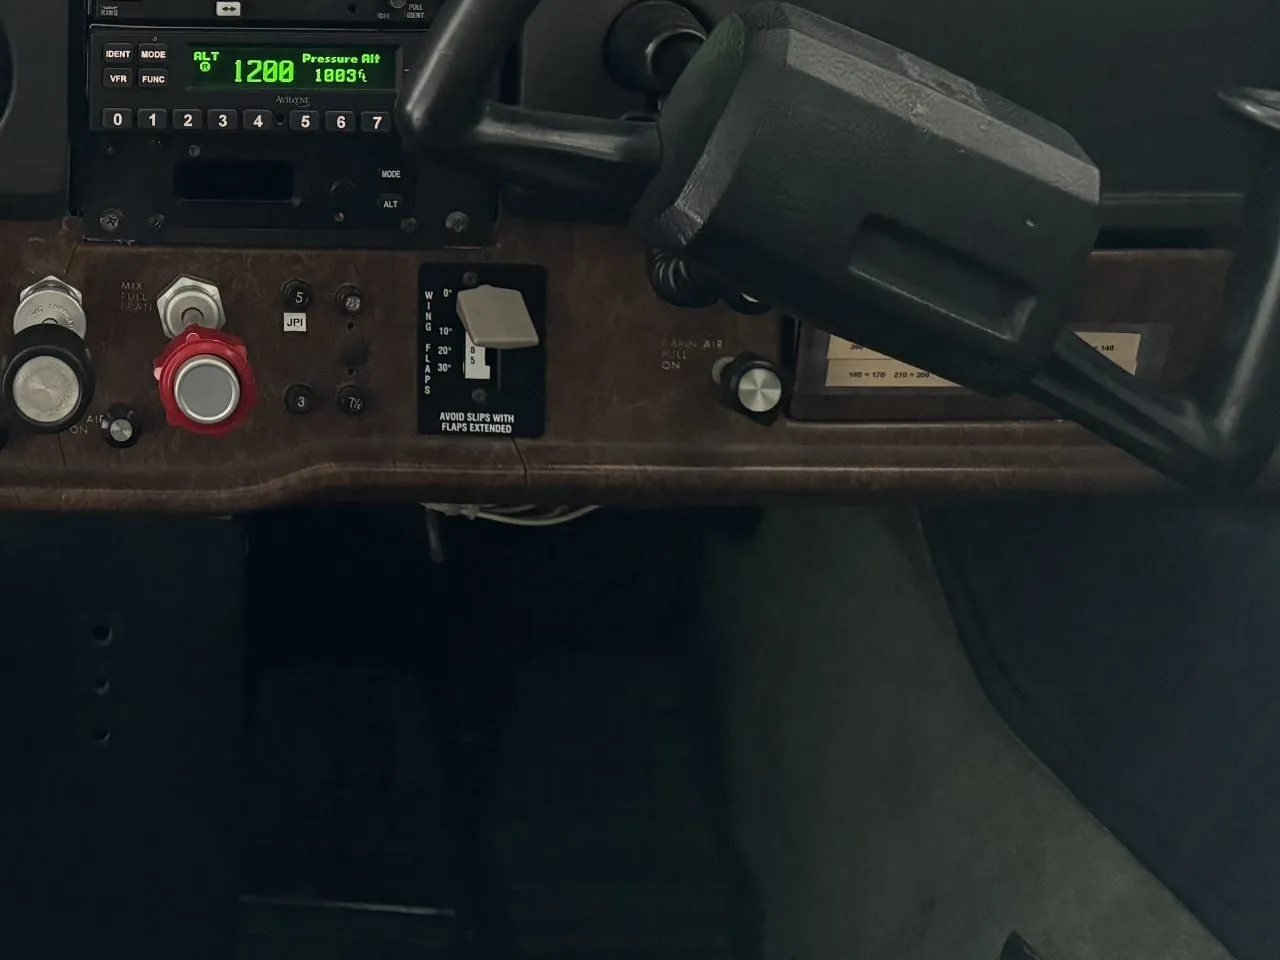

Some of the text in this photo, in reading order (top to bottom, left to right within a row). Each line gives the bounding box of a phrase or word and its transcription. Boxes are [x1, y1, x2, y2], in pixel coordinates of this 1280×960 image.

[106, 50, 131, 58] IDENT
[141, 50, 166, 59] MODE
[194, 51, 220, 61] ALT
[302, 53, 381, 64] Pressure Alt
[234, 59, 295, 83] 1200
[109, 74, 127, 83] VFR
[142, 75, 165, 84] FUNC
[382, 170, 403, 178] MODE
[384, 200, 400, 209] ALT
[121, 282, 142, 290] MIX
[424, 291, 434, 332] WING
[287, 318, 304, 327] JPI
[439, 412, 515, 424] AVOID SLIPS WITH
[441, 422, 512, 434] FLAPS EXTENDED
